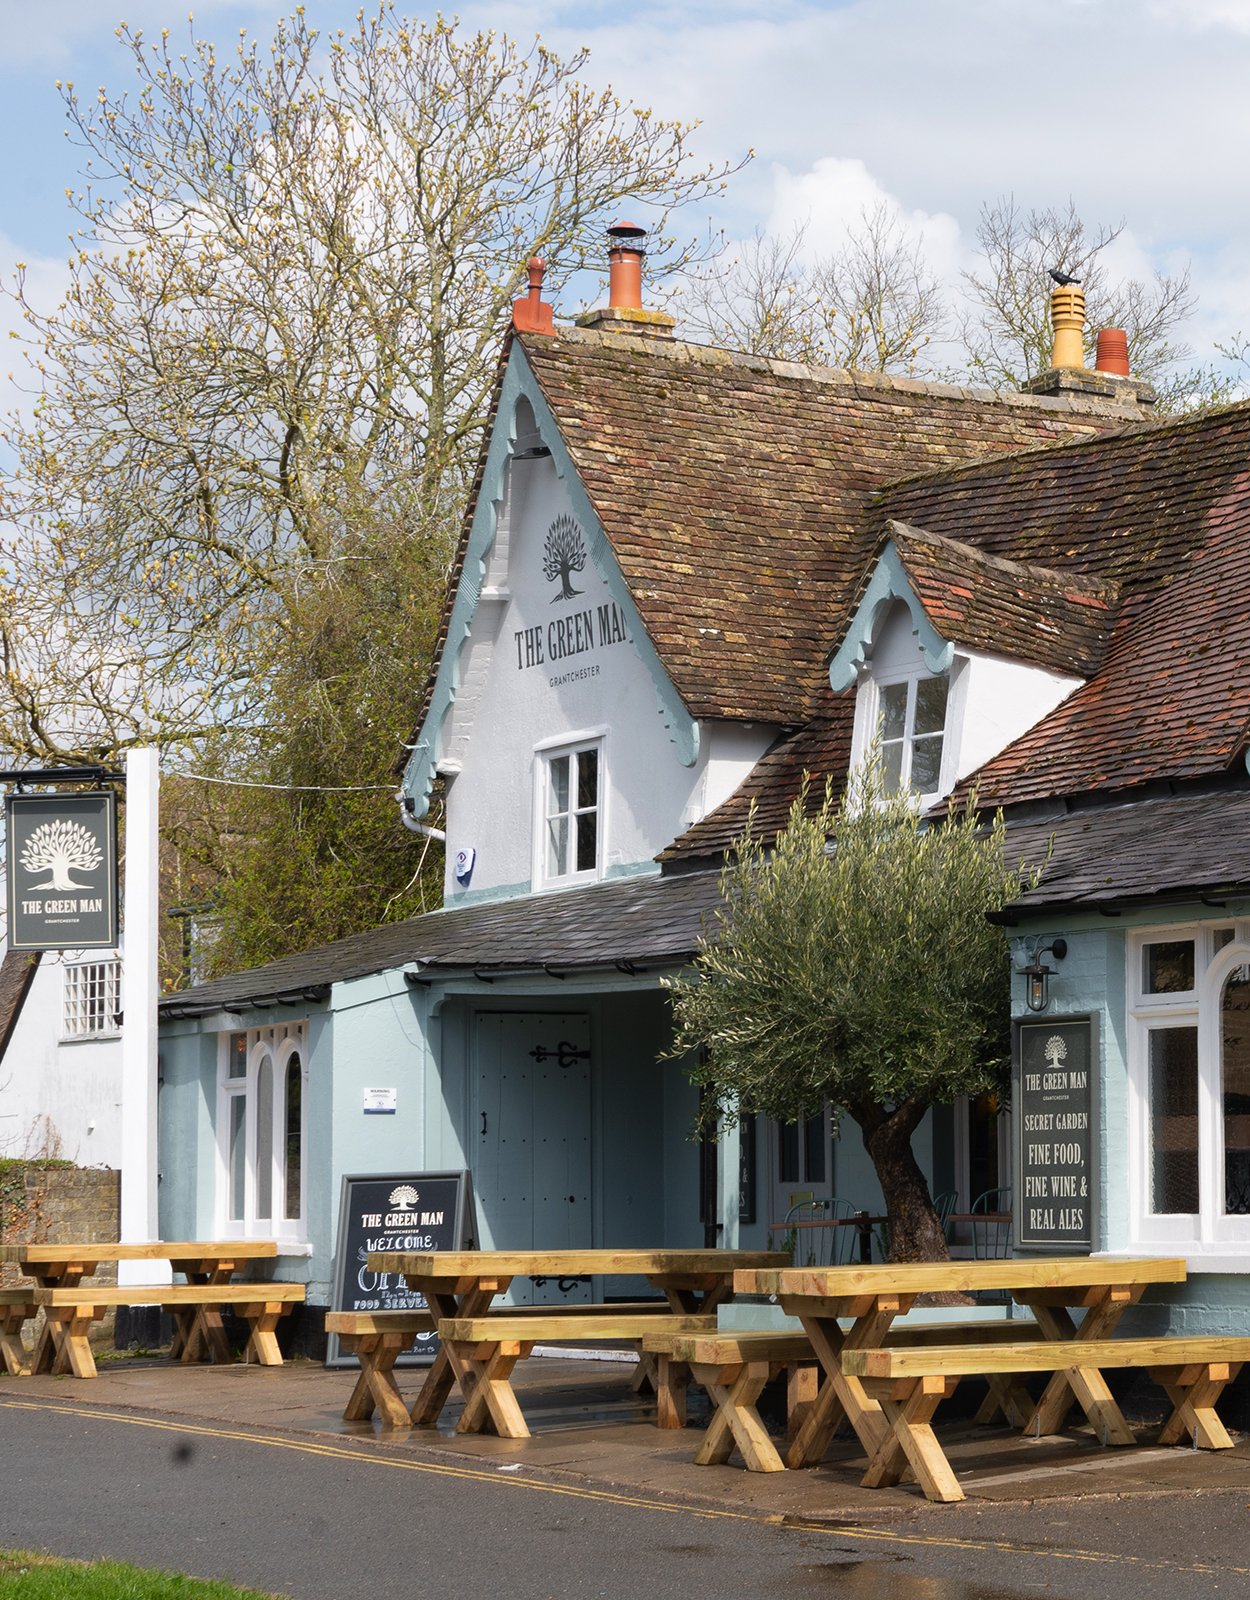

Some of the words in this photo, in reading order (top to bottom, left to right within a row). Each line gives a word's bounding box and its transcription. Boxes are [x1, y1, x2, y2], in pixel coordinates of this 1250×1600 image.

[514, 625, 545, 670] THE
[547, 609, 595, 662] GREEN
[549, 664, 601, 688] GRANTCHESTER
[21, 900, 42, 914] THE
[44, 899, 77, 914] GREEN
[79, 898, 103, 913] MAN
[1025, 1073, 1041, 1091] THE
[1042, 1072, 1068, 1090] GREEN
[1070, 1071, 1087, 1089] MAN
[1024, 1114, 1054, 1131] SECRET
[1056, 1112, 1088, 1130] GARDEN
[1028, 1144, 1051, 1166] FINE
[1053, 1142, 1085, 1168] FOOD,
[1025, 1176, 1048, 1198] FINE
[1050, 1175, 1077, 1198] WINE
[1079, 1175, 1088, 1198] &
[361, 1213, 382, 1228] THE
[384, 1212, 418, 1227] GREEN
[420, 1211, 444, 1226] MAN
[1030, 1208, 1056, 1230] REAL
[1058, 1208, 1084, 1231] ALES
[366, 1235, 433, 1252] WELCOME
[353, 1299, 380, 1310] FOOD
